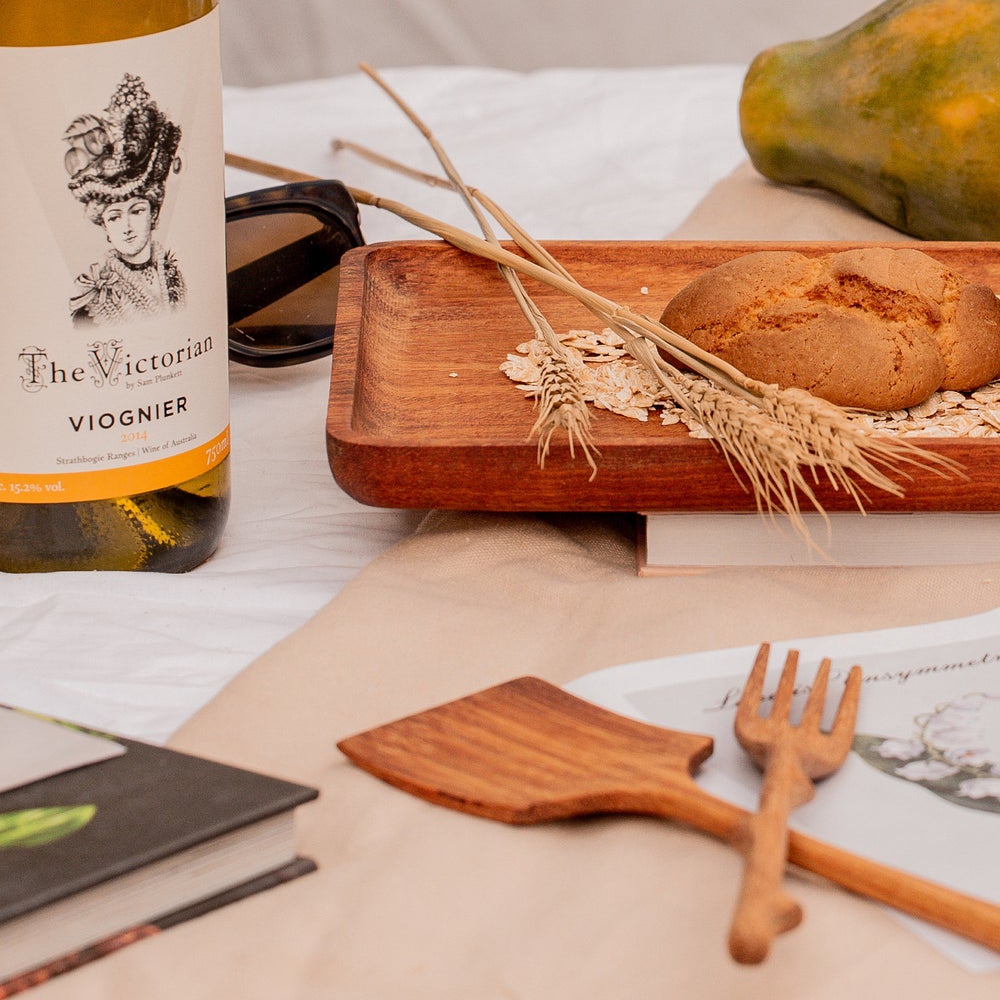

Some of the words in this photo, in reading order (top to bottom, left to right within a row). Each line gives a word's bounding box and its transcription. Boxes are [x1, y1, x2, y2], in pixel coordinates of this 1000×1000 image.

[18, 345, 85, 393] The
[86, 335, 213, 389] Victorian
[68, 396, 188, 432] VIOGNIER
[56, 454, 105, 465] Strathbogie
[107, 449, 136, 461] Ranges
[142, 445, 160, 454] Wine
[162, 440, 169, 449] of
[171, 432, 198, 447] Australia
[120, 430, 148, 443] 2014
[44, 480, 65, 492] vol.
